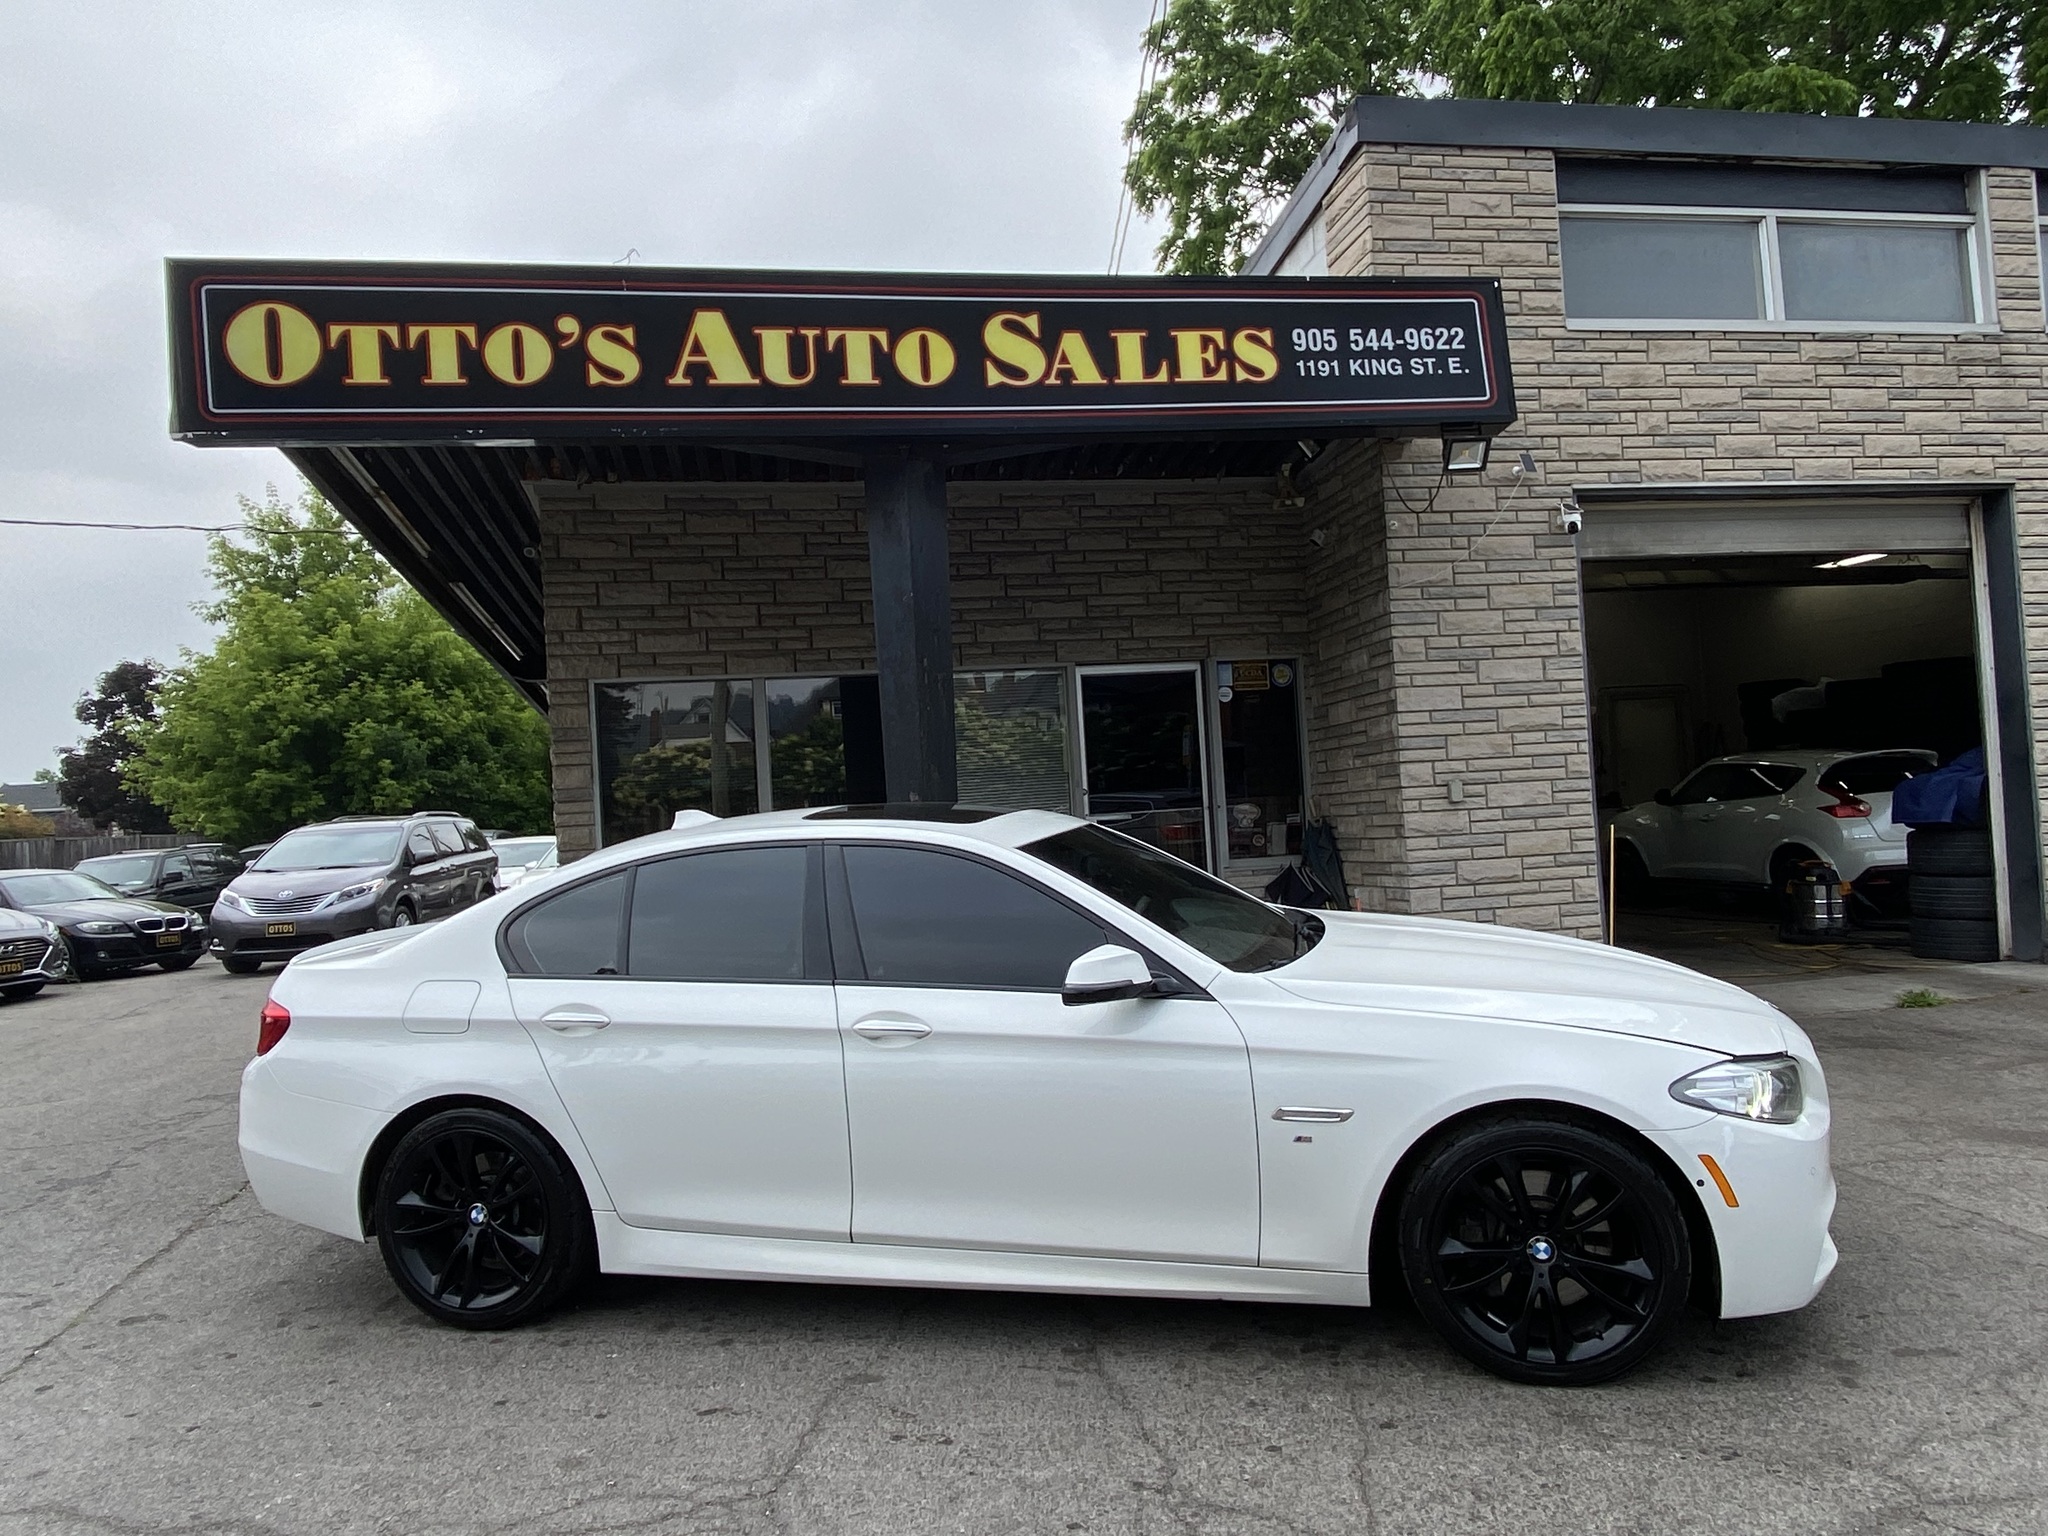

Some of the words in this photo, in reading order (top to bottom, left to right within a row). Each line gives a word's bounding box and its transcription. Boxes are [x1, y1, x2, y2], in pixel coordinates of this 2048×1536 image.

[667, 308, 957, 388] AUTO
[983, 310, 1280, 387] SALES
[1291, 328, 1338, 352] 905
[1349, 327, 1466, 351] 544-9622
[1296, 359, 1340, 377] 1191
[1348, 358, 1403, 376] KING
[1410, 357, 1443, 375] ST.
[1447, 357, 1470, 374] E.
[268, 924, 293, 933] OTTOS
